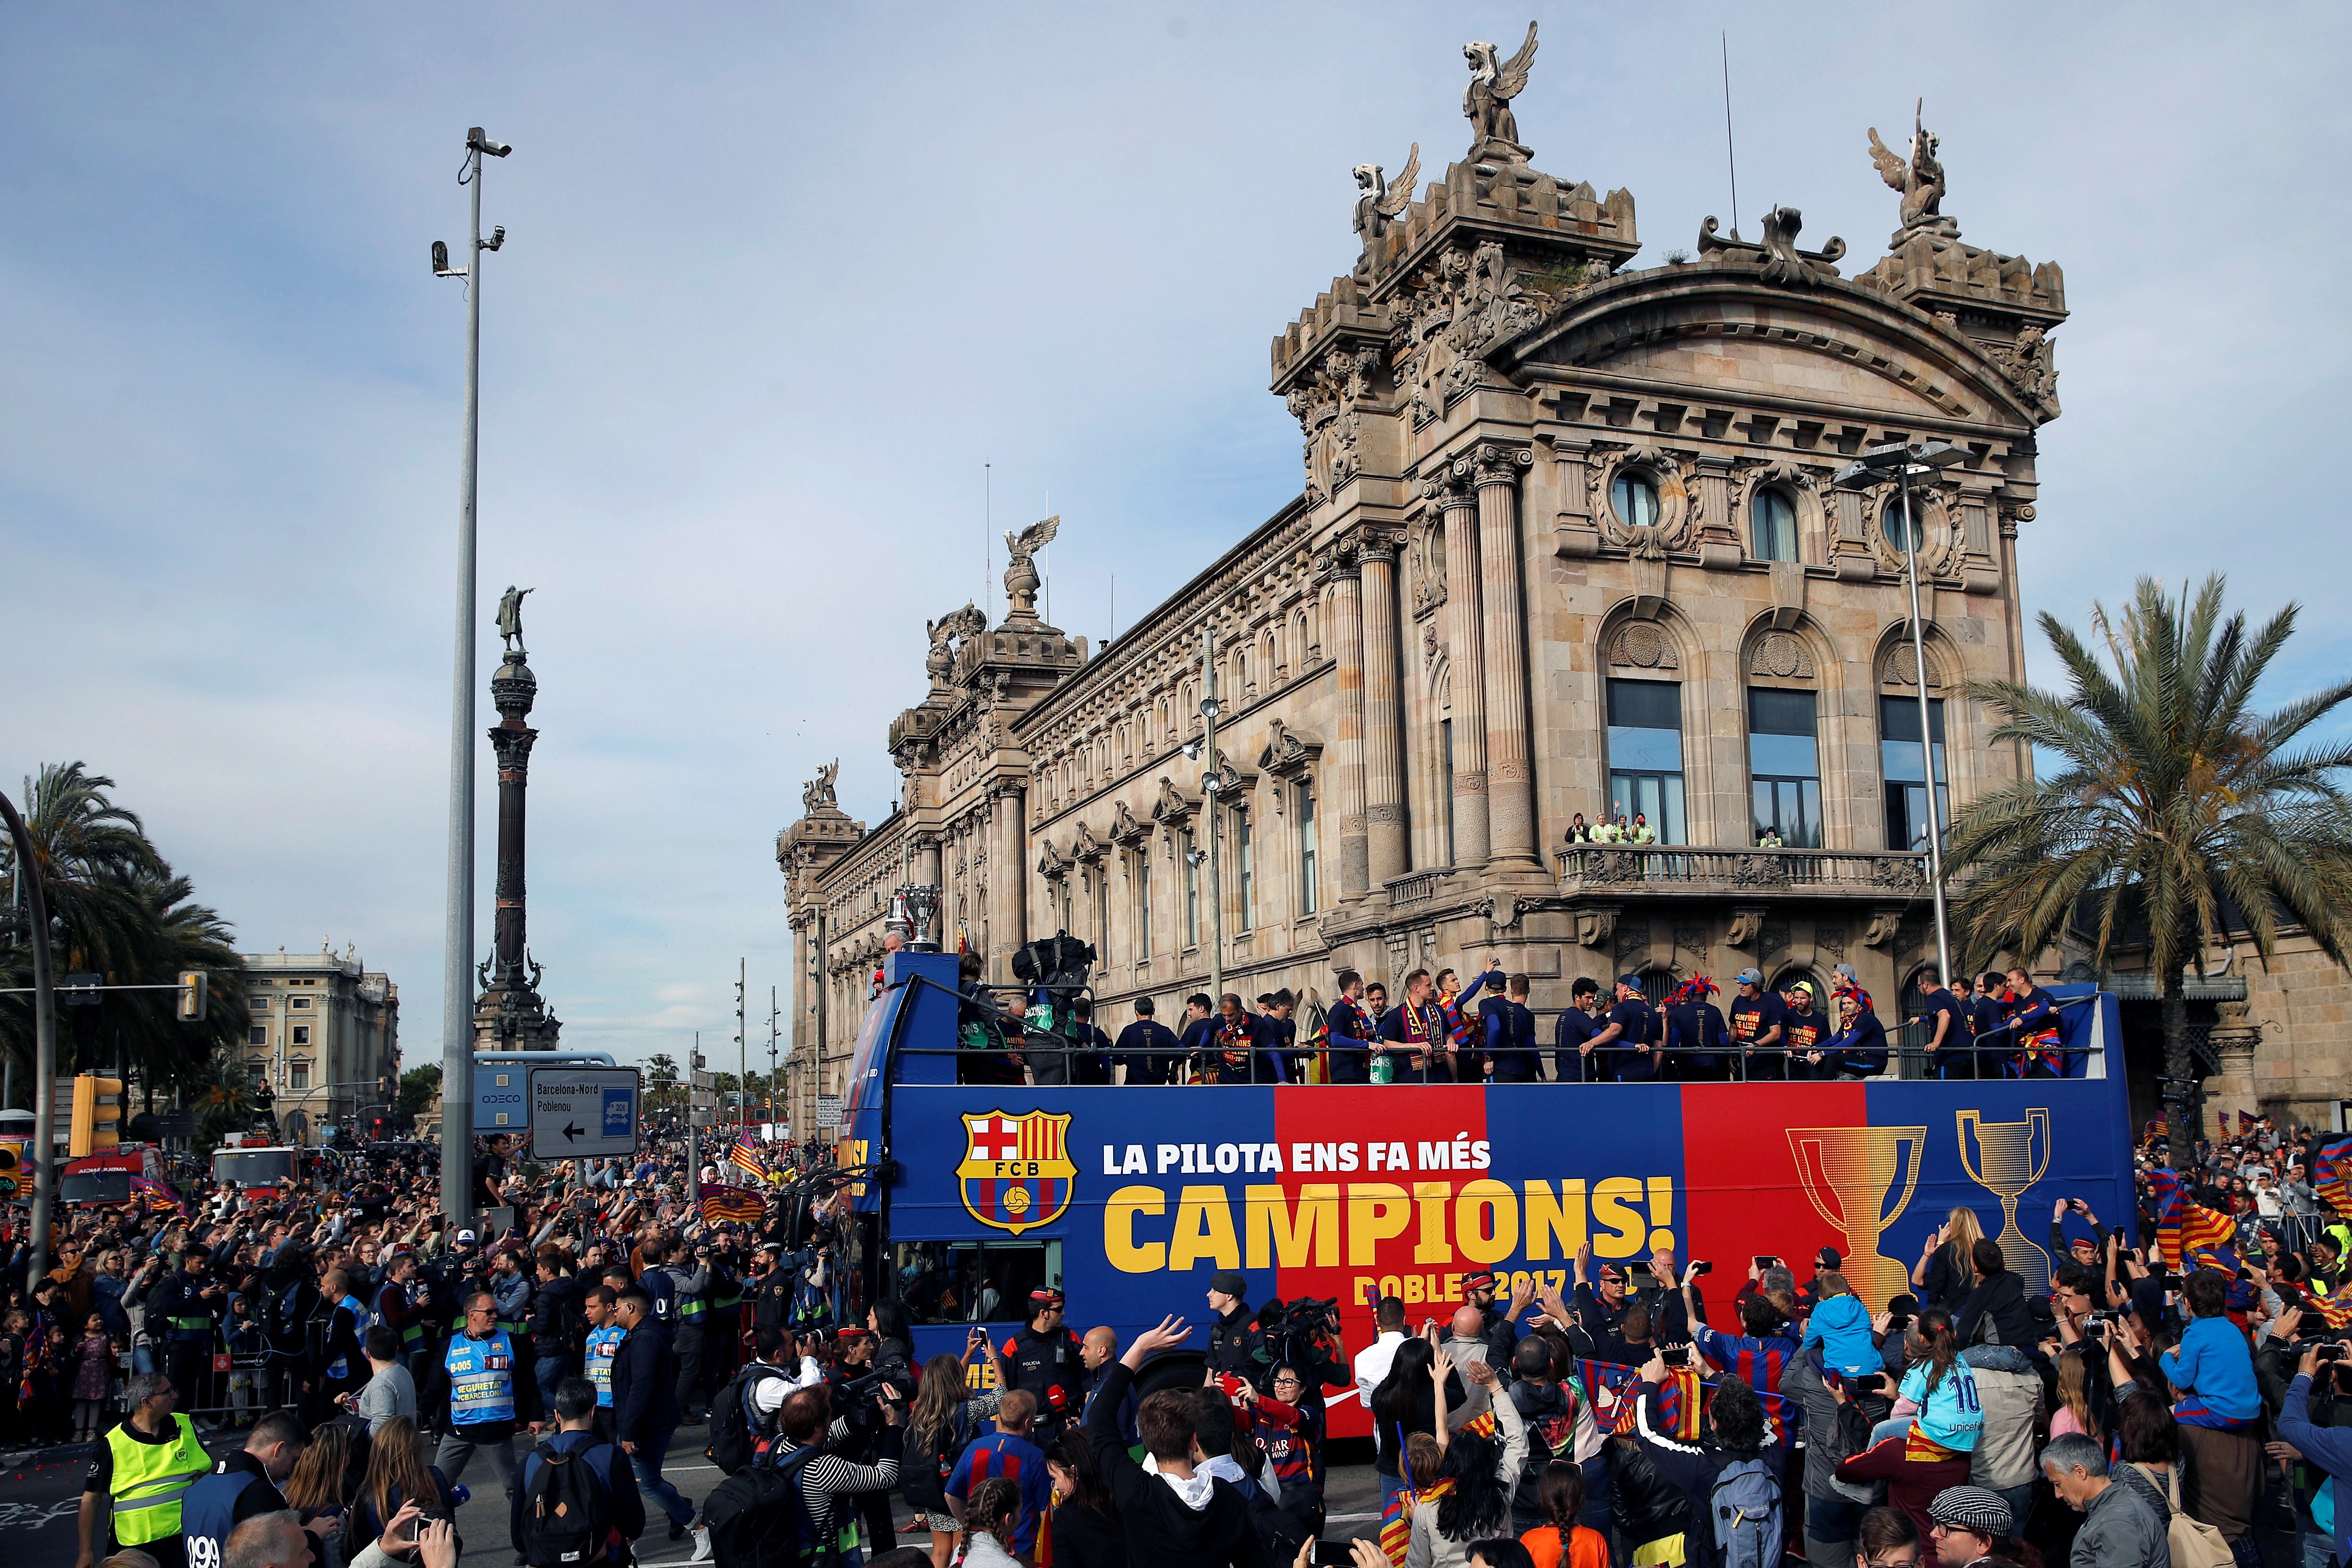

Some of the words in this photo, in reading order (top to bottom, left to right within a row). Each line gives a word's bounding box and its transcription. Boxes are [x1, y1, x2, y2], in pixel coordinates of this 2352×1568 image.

[1735, 1014, 1759, 1023] CAMPIONS
[1743, 1022, 1756, 1031] LLIGA
[1789, 1027, 1816, 1039] CAMPIONS
[1797, 1036, 1812, 1046] LLIGA
[537, 1084, 598, 1095] Barcelona-Nord
[482, 1094, 521, 1103] ODECO
[537, 1101, 571, 1112] Poblenou
[1104, 1145, 1147, 1174] LA
[1157, 1143, 1283, 1174] PILOTA
[1292, 1142, 1358, 1172] ENS
[1368, 1142, 1409, 1171] FA
[1418, 1131, 1491, 1170] MÉS
[1104, 1177, 1675, 1273] CAMPIONS!
[1354, 1273, 1467, 1305] DOBLE
[1493, 1270, 1566, 1300] 2017
[450, 1360, 472, 1373] B-005
[457, 1381, 502, 1394] SEGURETAT
[457, 1390, 503, 1401] FCBARCELONA
[1947, 1375, 1980, 1414] 10
[1949, 1421, 1977, 1432] unicef
[187, 1535, 220, 1568] 099
